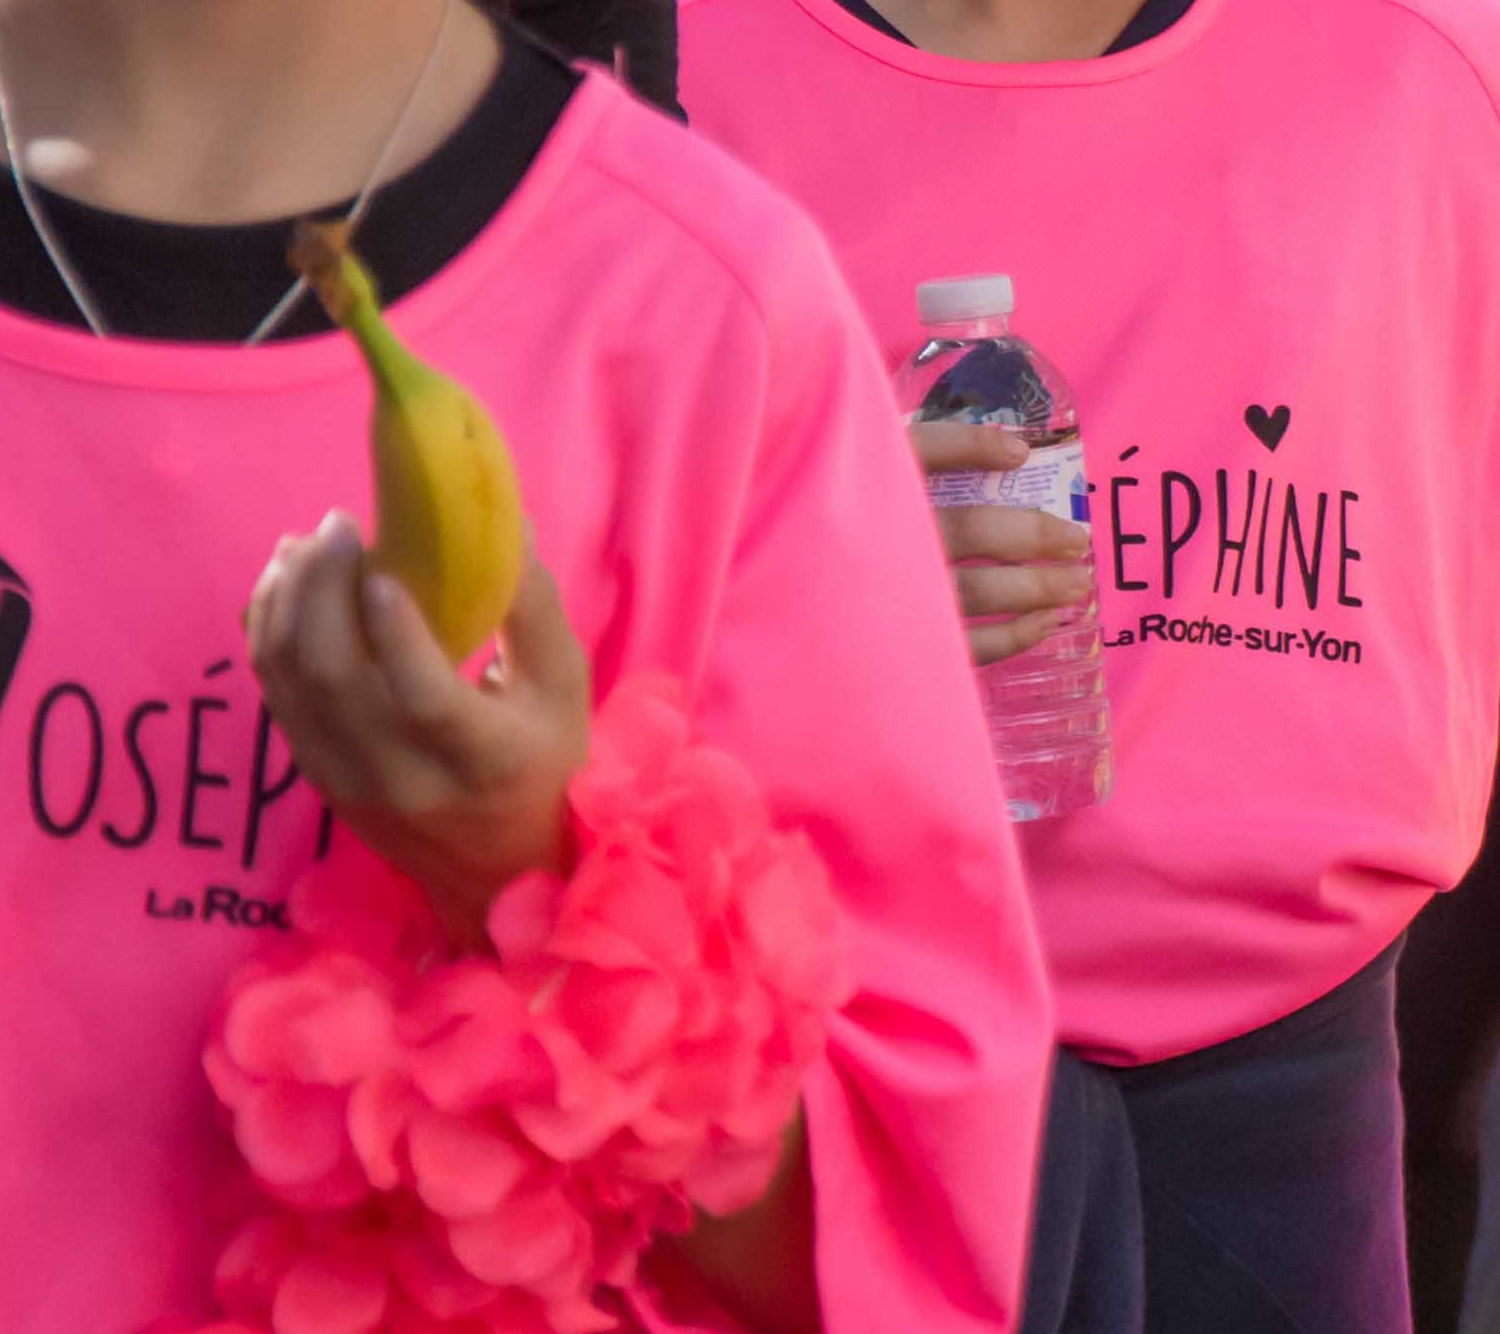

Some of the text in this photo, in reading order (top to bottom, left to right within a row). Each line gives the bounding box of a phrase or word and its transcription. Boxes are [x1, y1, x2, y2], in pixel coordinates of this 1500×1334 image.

[1088, 445, 1363, 611] ÉPHINE
[1139, 613, 1362, 665] Roche-sur-Yon
[145, 888, 196, 920] La
